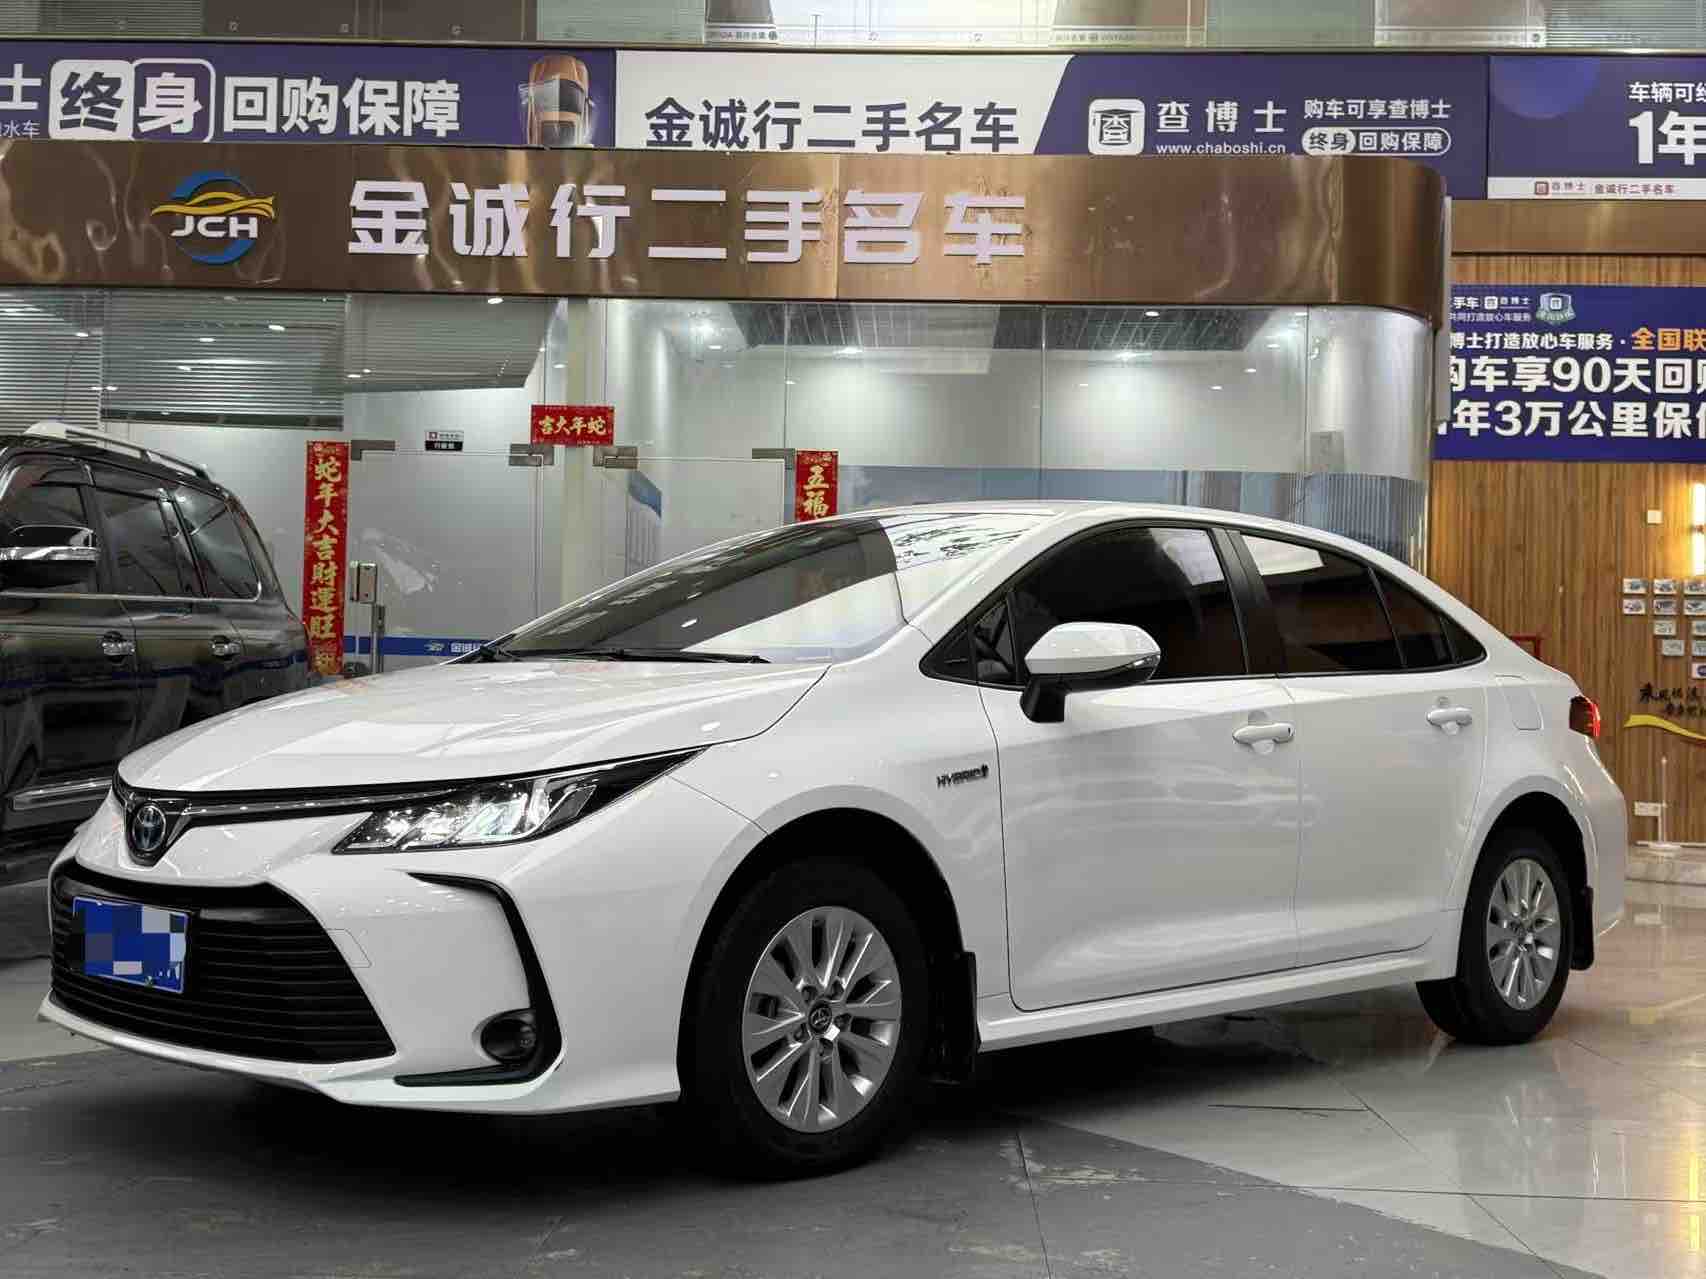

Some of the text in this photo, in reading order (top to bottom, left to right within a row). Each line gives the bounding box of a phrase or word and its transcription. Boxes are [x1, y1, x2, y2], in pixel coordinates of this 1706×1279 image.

[1156, 101, 1287, 133] 查博士
[1303, 99, 1451, 120] 购车可享查博士
[0, 121, 40, 138] 水车
[645, 97, 1019, 153] 金诚行二手名车
[1156, 142, 1287, 155] www.chaboshi.cn
[1308, 131, 1444, 153] 终身回购保障
[1628, 110, 1706, 166] 1年
[171, 216, 258, 239] JCH
[348, 179, 1026, 266] 金诚行二手名车
[1449, 296, 1480, 309] 手车
[1437, 399, 1706, 439] 年3万公里保
